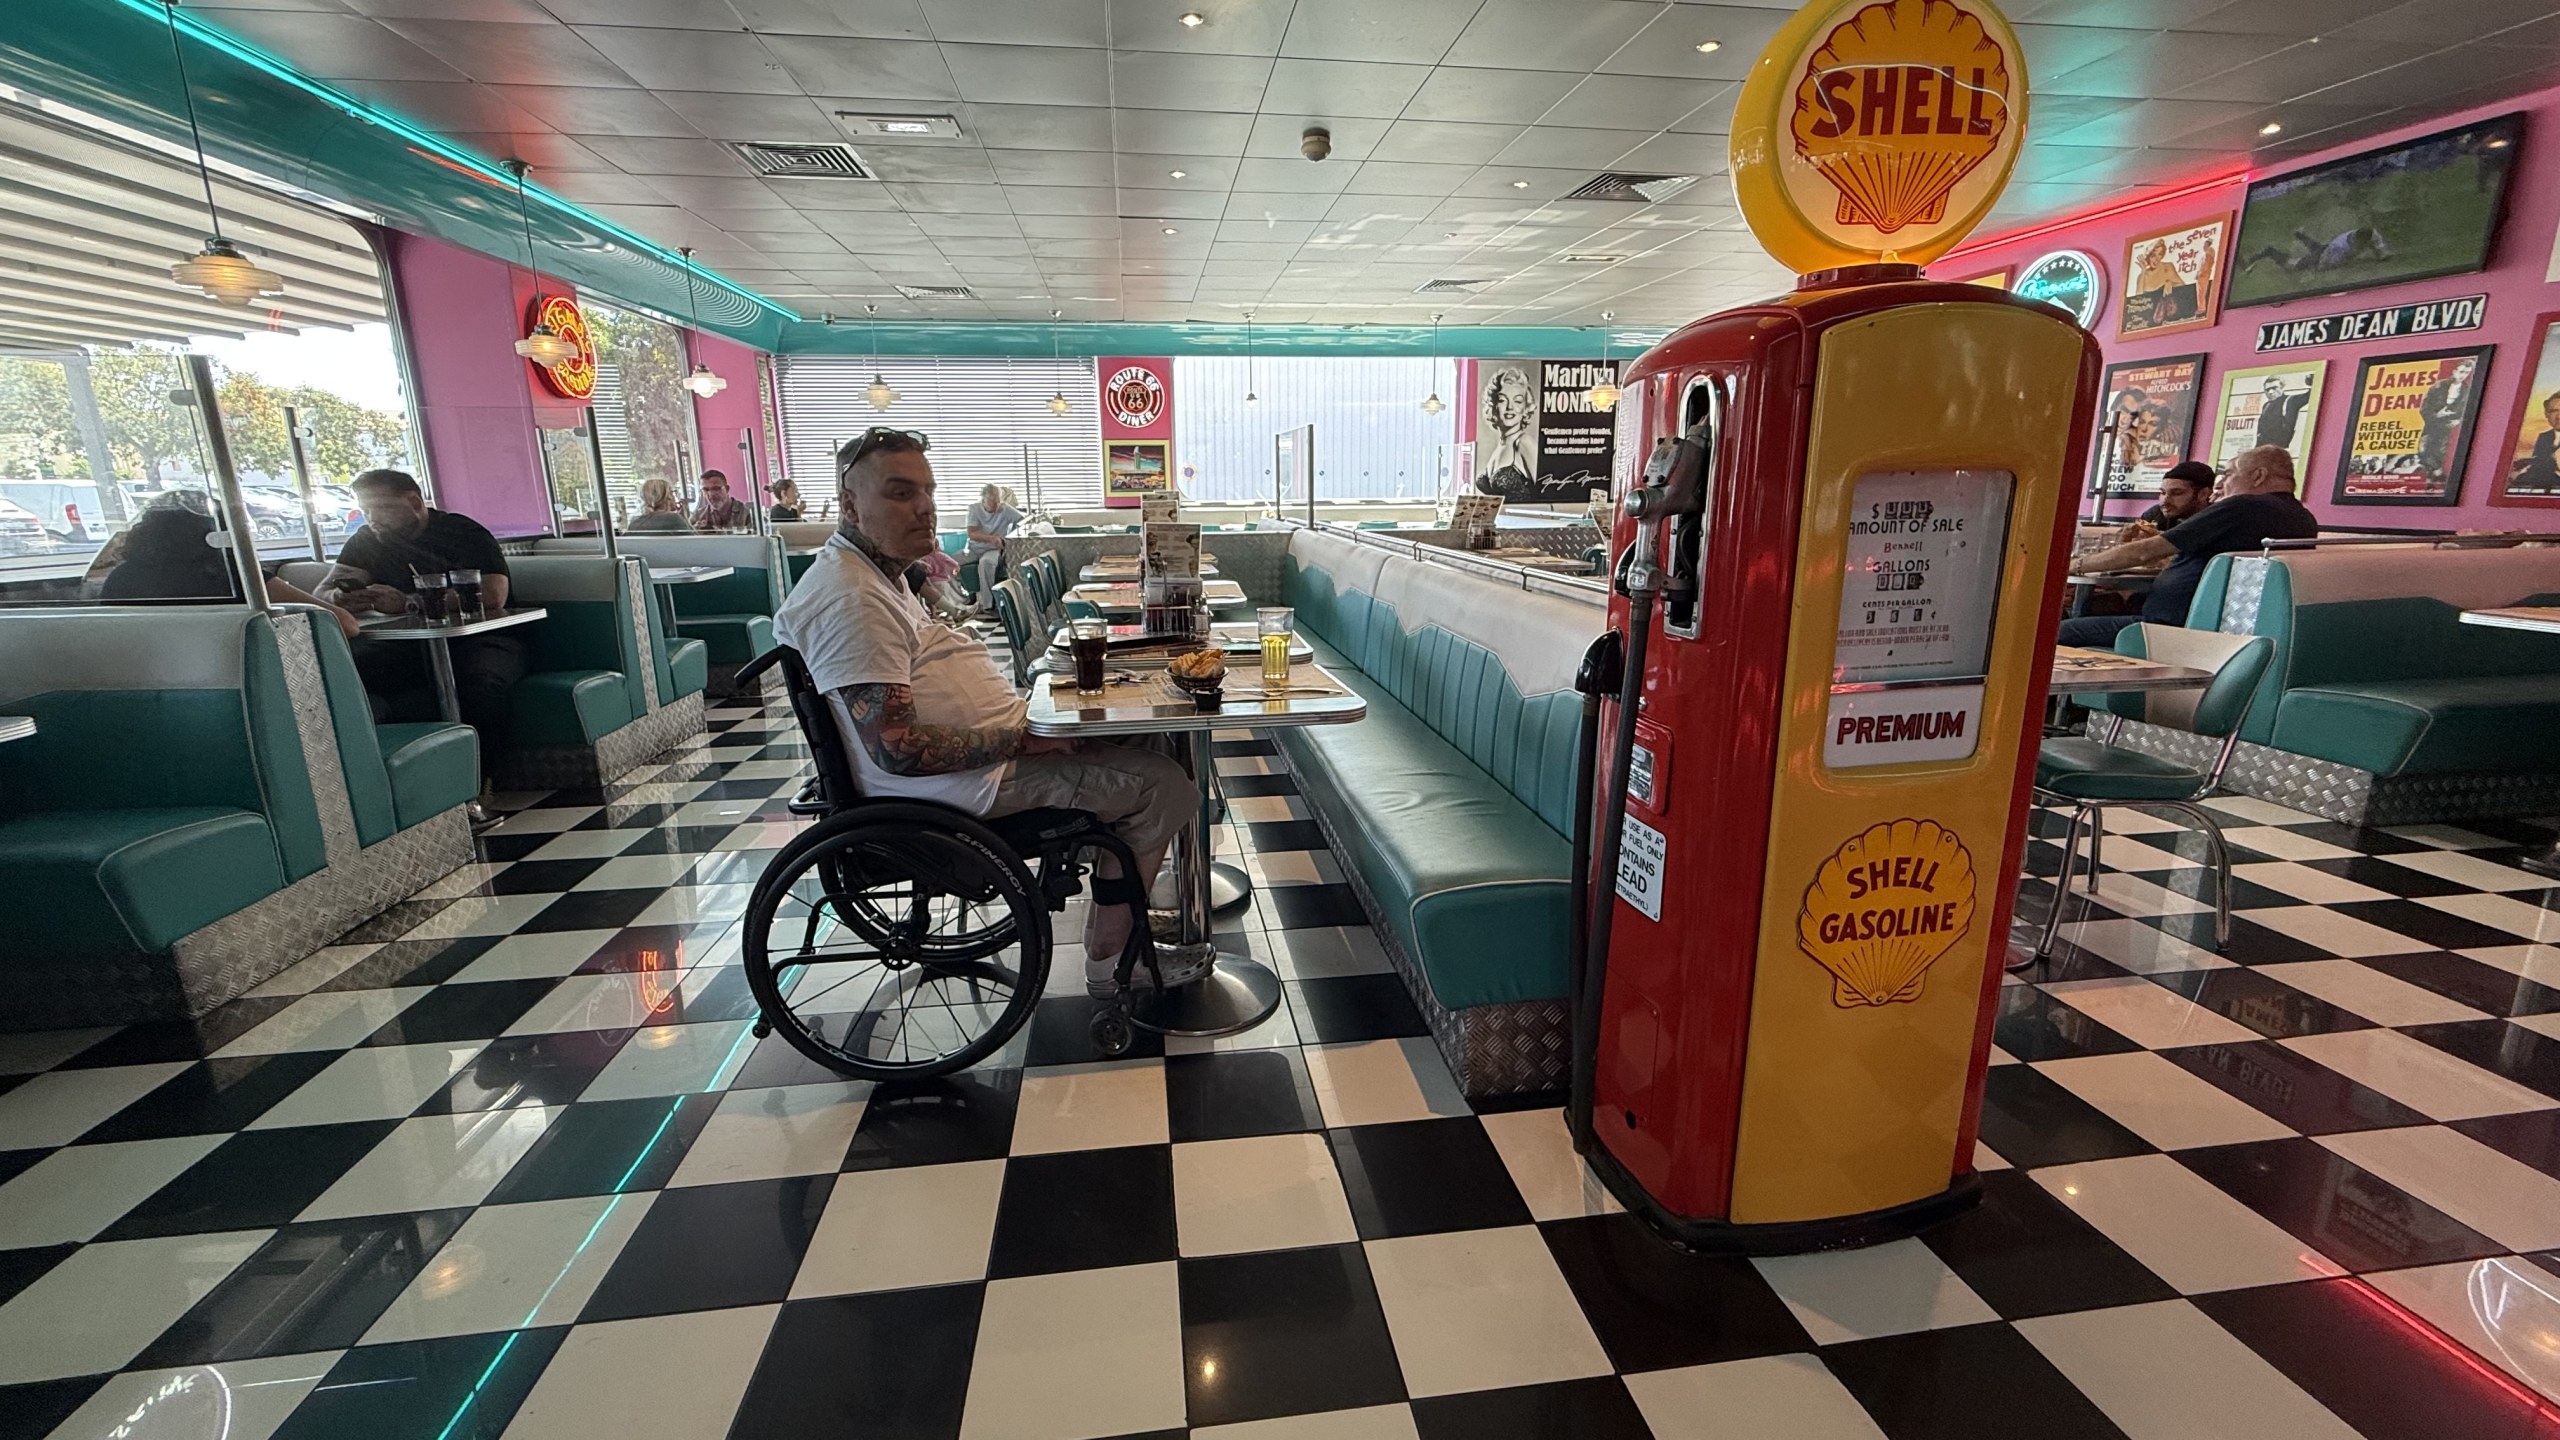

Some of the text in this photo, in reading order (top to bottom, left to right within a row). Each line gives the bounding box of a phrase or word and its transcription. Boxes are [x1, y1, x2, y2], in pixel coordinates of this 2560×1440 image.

[1809, 65, 1994, 138] SHELL
[2168, 227, 2217, 253] the seven
[2176, 250, 2199, 263] year
[2178, 260, 2197, 273] itch
[2264, 300, 2473, 349] JAMES DEAN BLVD
[1110, 368, 1160, 392] ROUTE 66
[2146, 381, 2192, 393] HITCHCOCK'S
[2368, 366, 2439, 391] JAMES
[1128, 398, 1144, 409] 66
[2363, 393, 2424, 417] DEAN
[1118, 411, 1155, 427] DINER
[2226, 418, 2255, 430] BULLITT
[2360, 420, 2403, 431] REBEL
[1569, 437, 1590, 445] blondes
[1591, 437, 1605, 445] know
[2358, 429, 2422, 440] WITHOUT
[2355, 440, 2416, 451] A CAUSE
[2109, 474, 2126, 482] OO
[2110, 465, 2135, 474] NEW
[1849, 518, 1964, 536] AMOUNT OF SALE
[1873, 559, 1930, 573] GALLONS
[1862, 600, 1885, 608] CENTS
[1901, 598, 1932, 607] GALLON
[1836, 710, 1967, 746] PREMIUM
[1628, 820, 1641, 835] USE
[1643, 829, 1652, 842] AS
[1655, 836, 1661, 847] A
[1629, 834, 1644, 850] FUEL
[1647, 845, 1664, 861] ONLY
[955, 832, 1027, 897] SPINERGY
[1619, 844, 1656, 876] ONTAINS
[1846, 856, 1940, 900] SHELL
[1819, 901, 1958, 945] GASOLINE
